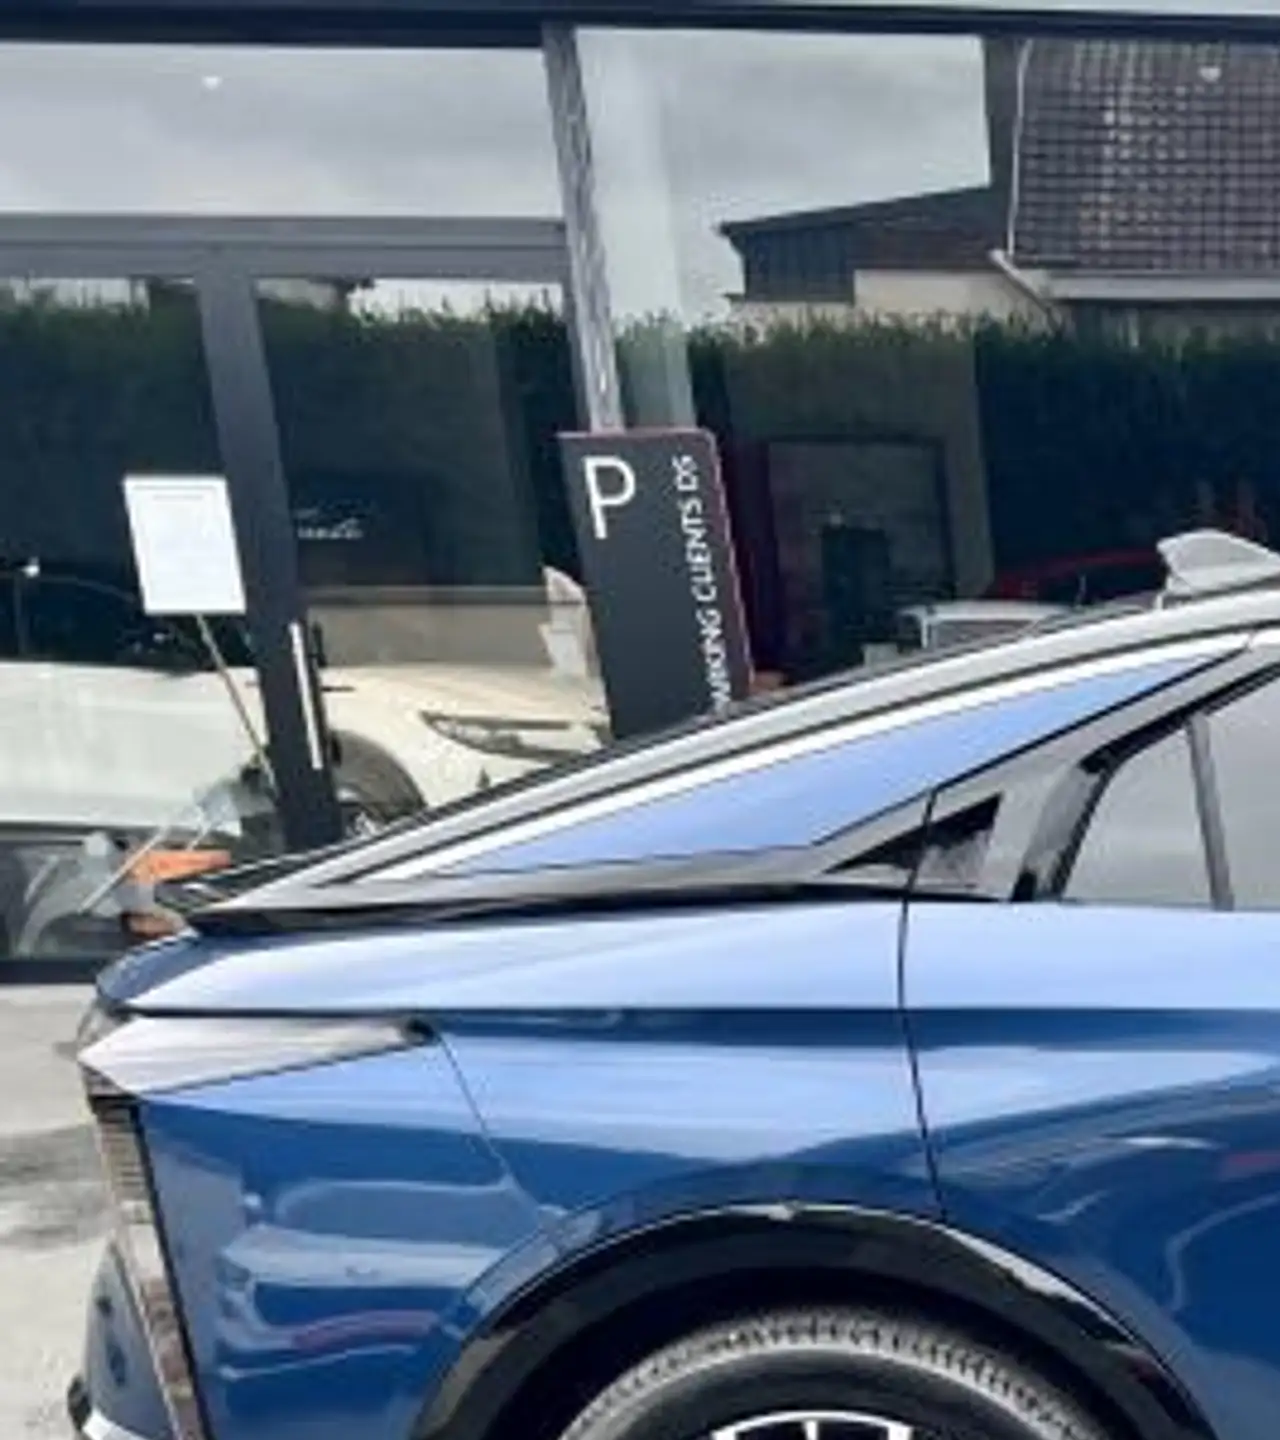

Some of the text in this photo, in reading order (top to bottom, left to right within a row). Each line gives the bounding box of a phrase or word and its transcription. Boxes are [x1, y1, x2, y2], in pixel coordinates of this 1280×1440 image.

[584, 455, 636, 539] P
[672, 454, 732, 709] ARKING CLIENTS DS
